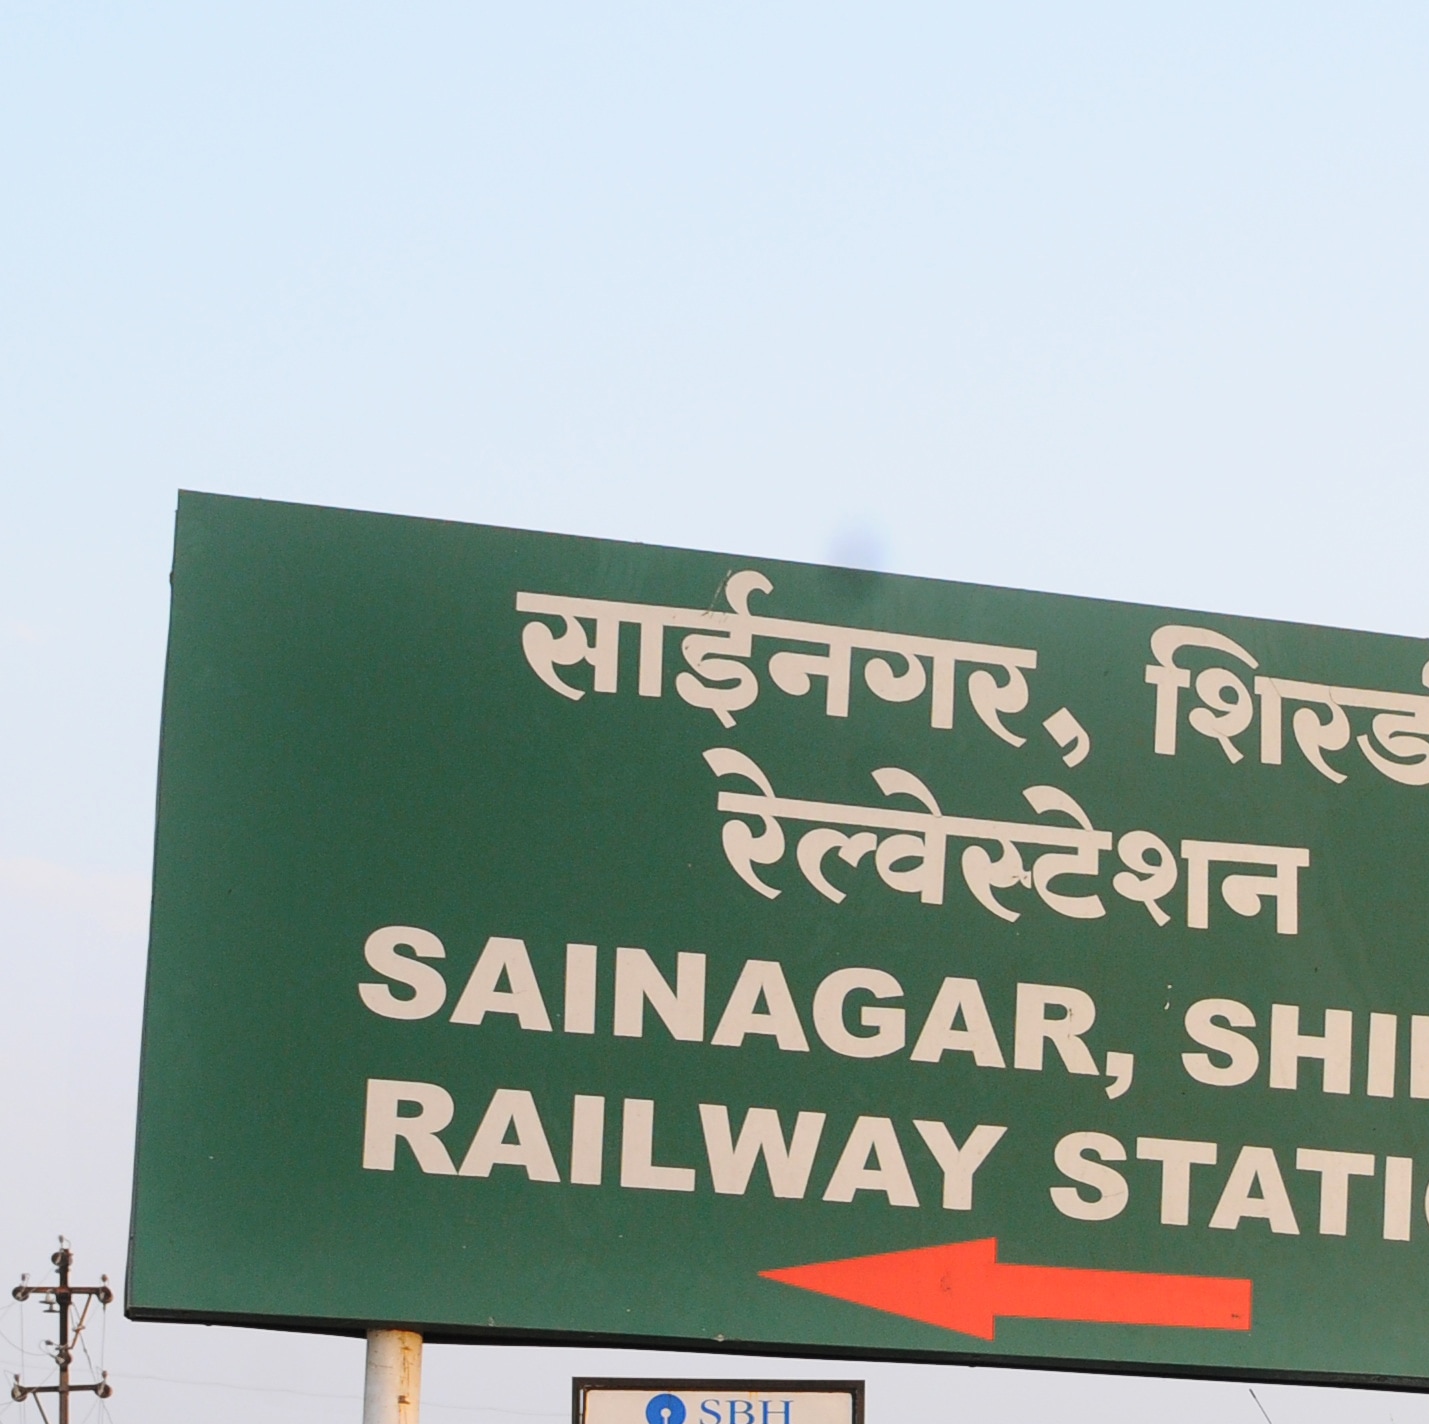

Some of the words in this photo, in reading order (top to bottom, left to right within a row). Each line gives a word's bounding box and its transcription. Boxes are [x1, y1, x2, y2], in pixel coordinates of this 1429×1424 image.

[517, 570, 1090, 766] साईनगर,
[704, 747, 1309, 935] रेल्वेस्टेशन
[357, 925, 1135, 1099] SAINAGAR,
[361, 1077, 1008, 1212] RAILWAY
